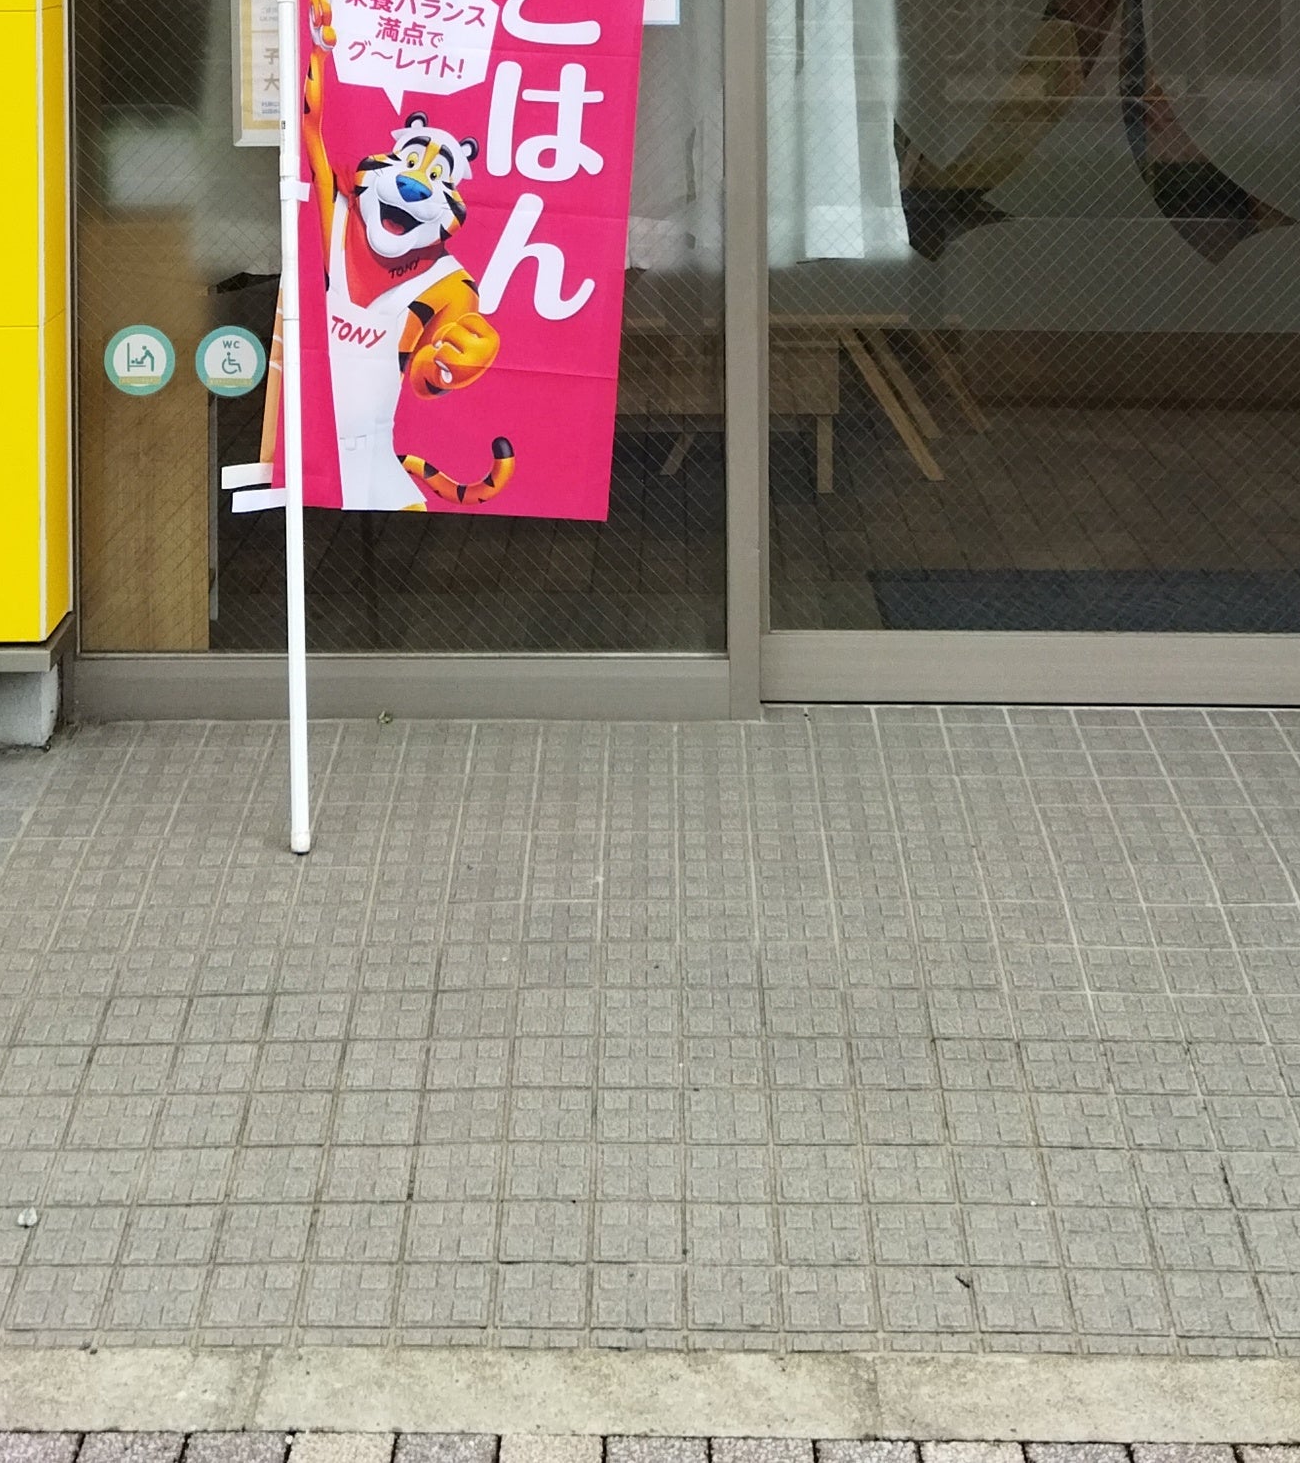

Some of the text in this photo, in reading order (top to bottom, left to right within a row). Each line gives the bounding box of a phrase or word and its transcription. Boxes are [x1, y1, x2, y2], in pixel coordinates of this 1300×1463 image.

[375, 15, 445, 49] 満点で
[388, 257, 420, 279] TONY
[222, 340, 241, 349] WC
[330, 314, 387, 349] TONY
